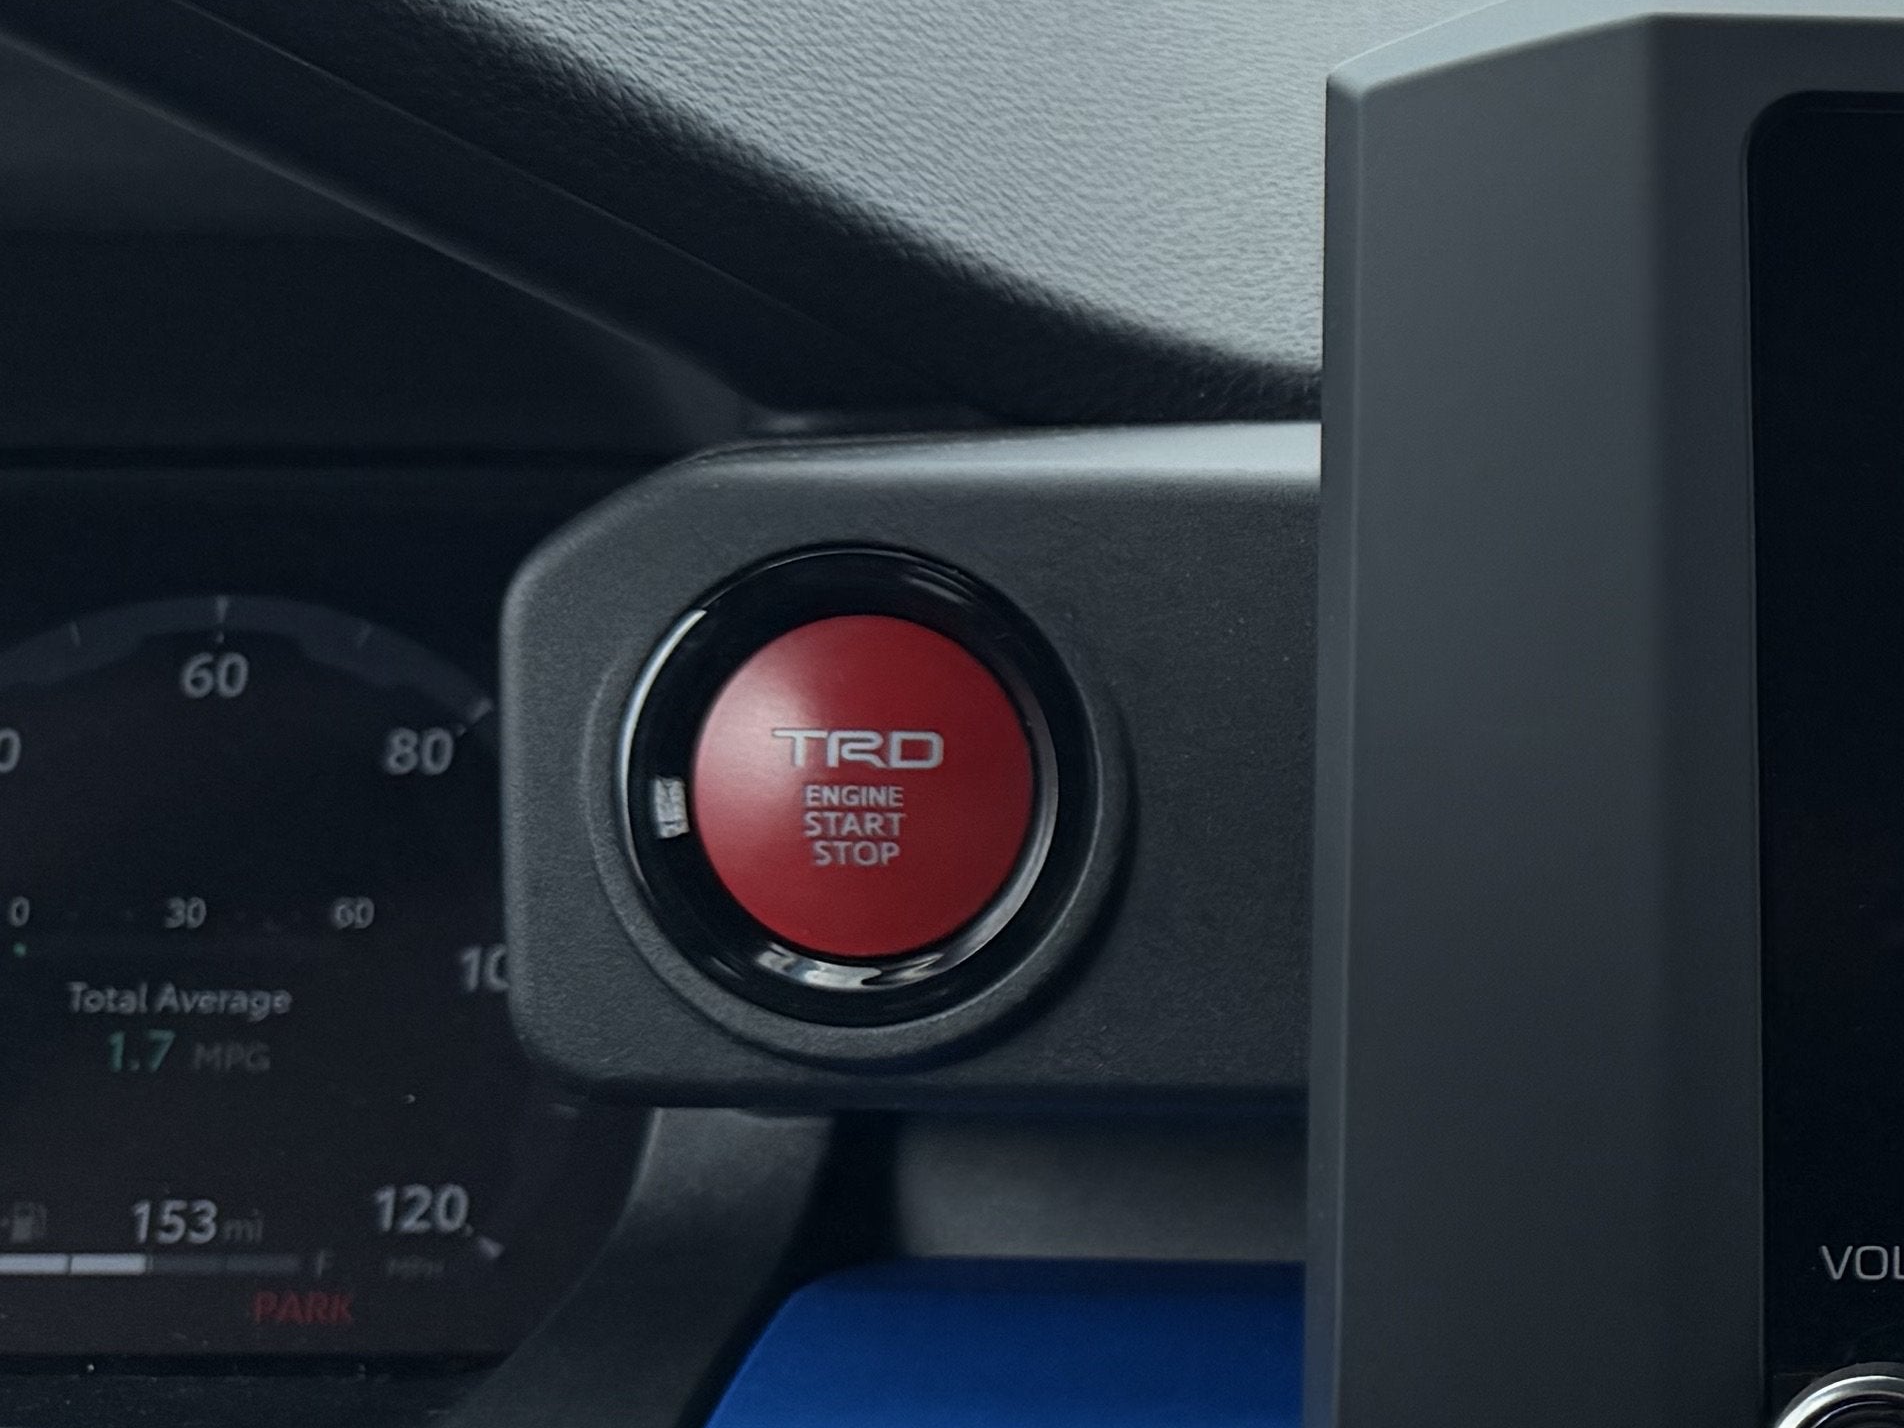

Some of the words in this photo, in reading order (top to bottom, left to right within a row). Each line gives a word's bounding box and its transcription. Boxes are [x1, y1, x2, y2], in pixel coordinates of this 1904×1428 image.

[180, 652, 249, 698] 60
[0, 727, 22, 774] 0
[384, 726, 455, 776] 80
[771, 728, 944, 769] TRD
[805, 785, 904, 808] ENGINE
[804, 811, 906, 837] START
[812, 840, 900, 866] STOP
[8, 896, 30, 927] 0
[164, 896, 207, 929] 30
[329, 896, 375, 929] 60
[461, 944, 508, 992] 10
[66, 981, 148, 1014] Total
[154, 982, 293, 1021] Average
[107, 1029, 176, 1072] 1.7
[194, 1041, 270, 1071] MPG
[132, 1198, 219, 1244] 153
[224, 1208, 265, 1244] mi
[374, 1183, 471, 1234] 120
[251, 1291, 354, 1325] PARK
